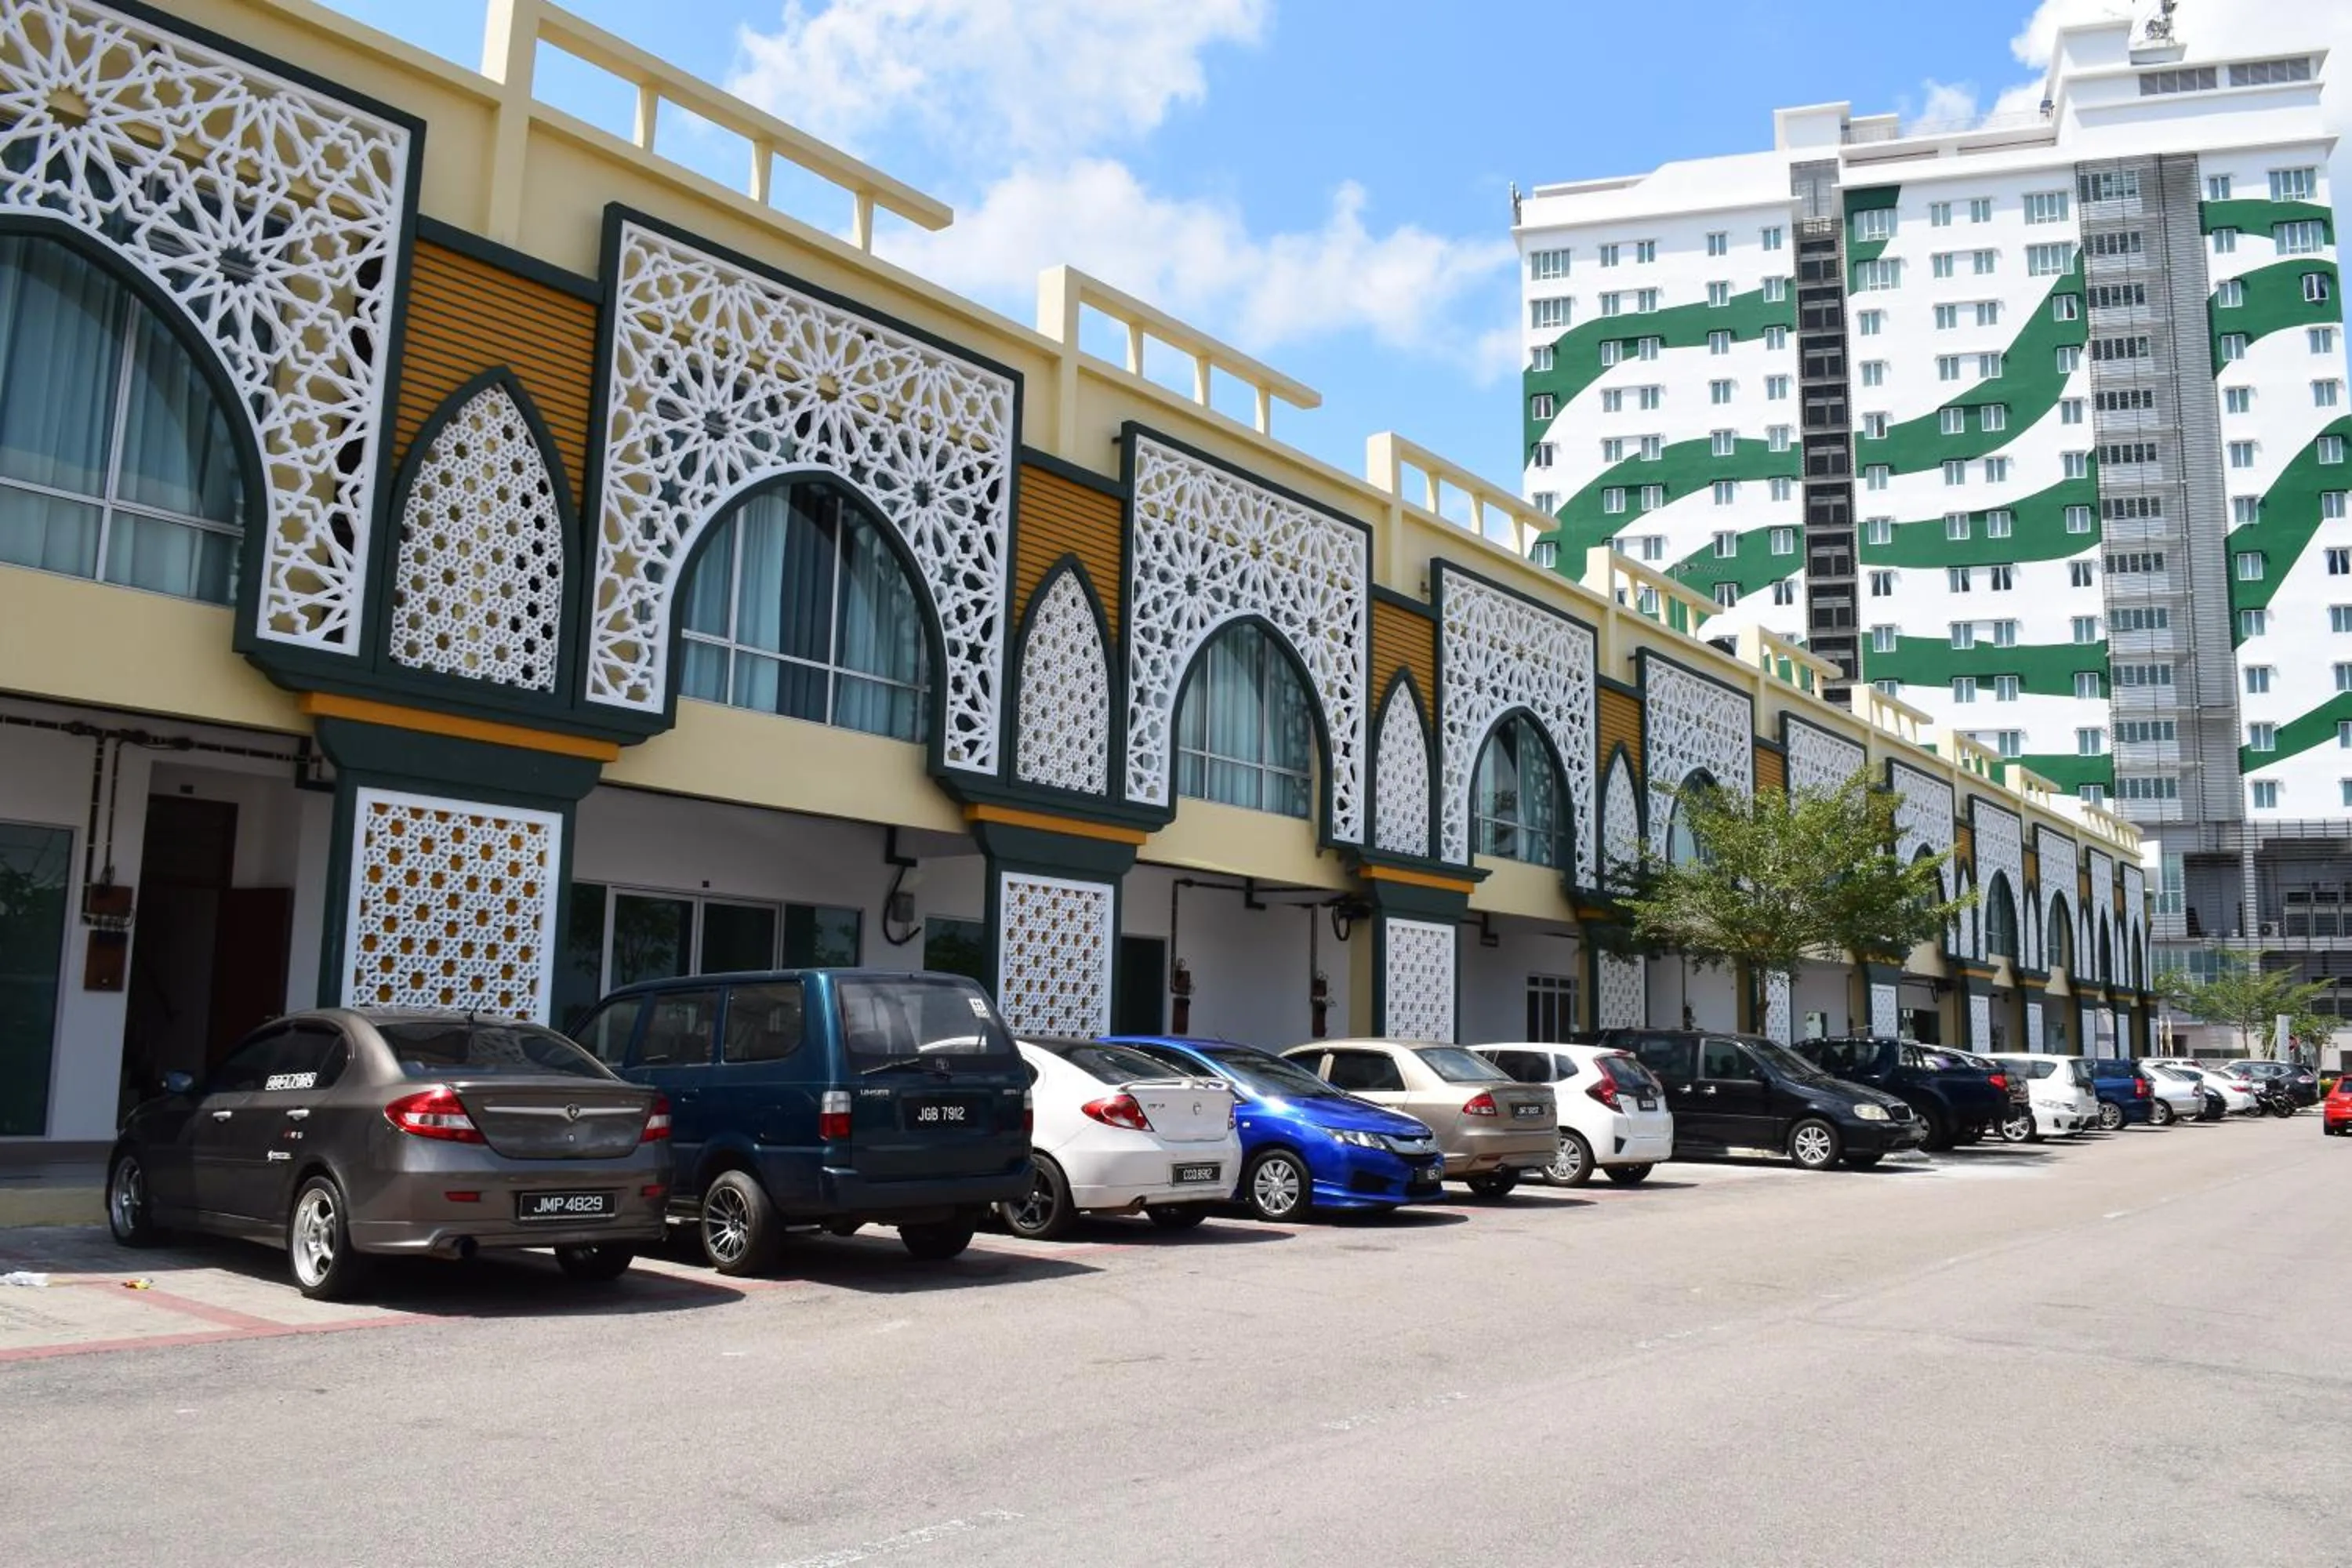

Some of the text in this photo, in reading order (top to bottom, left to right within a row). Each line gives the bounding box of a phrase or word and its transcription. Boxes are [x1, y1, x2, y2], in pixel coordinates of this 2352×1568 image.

[917, 1106, 965, 1121] JGB 7912
[534, 1196, 603, 1213] JMP 4829
